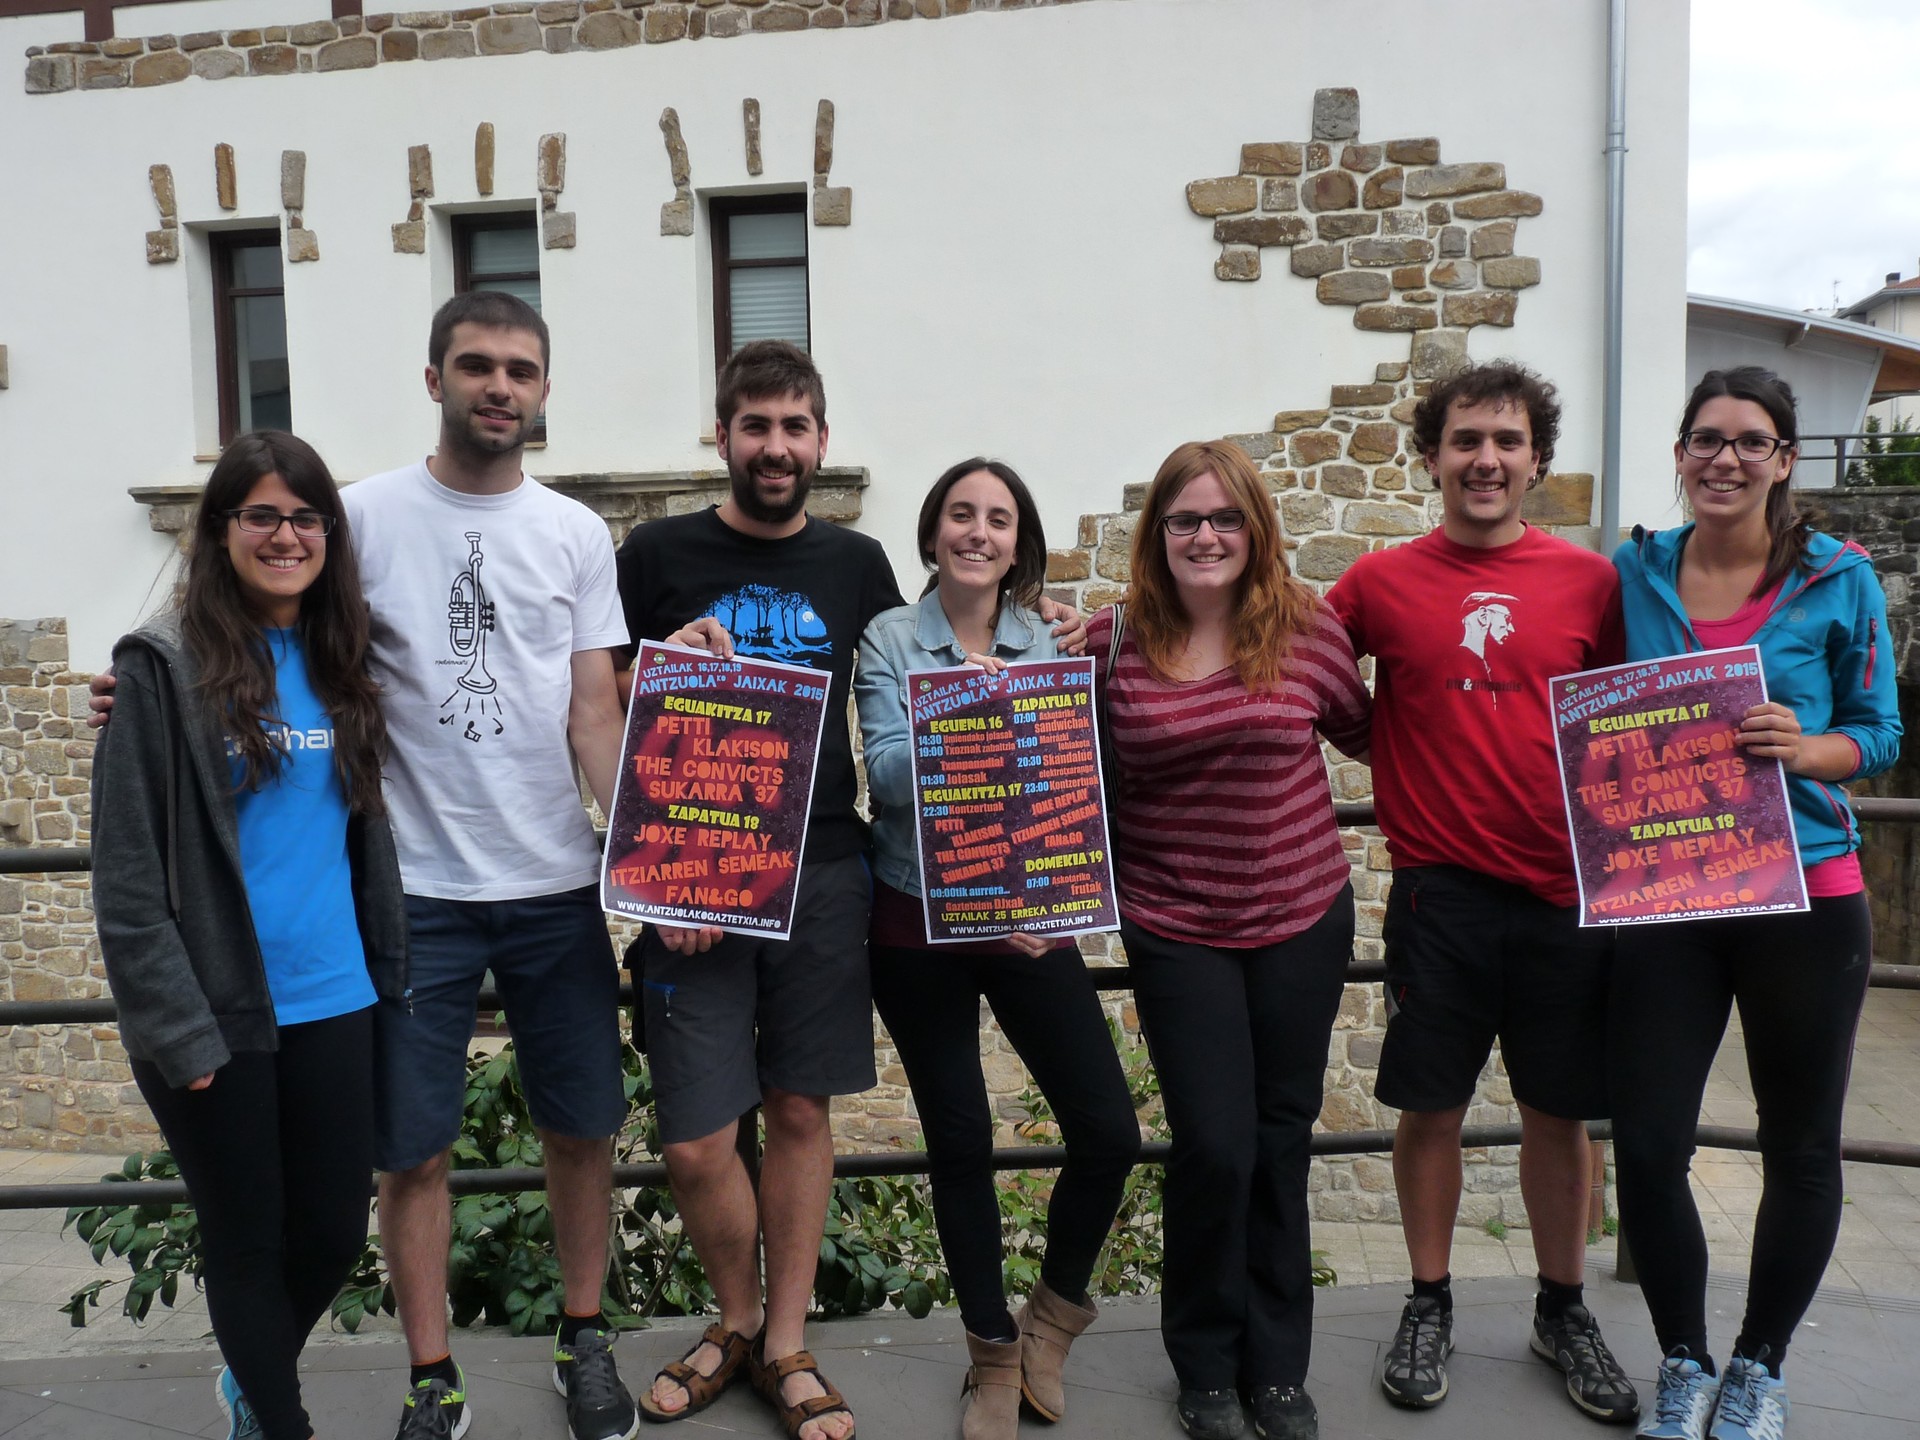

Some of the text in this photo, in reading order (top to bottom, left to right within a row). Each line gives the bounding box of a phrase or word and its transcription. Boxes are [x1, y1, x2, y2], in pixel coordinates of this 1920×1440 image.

[643, 662, 742, 678] UZTAILAK 16,17,18,19
[1656, 666, 1716, 690] JAIXAK
[1724, 662, 1758, 678] 2015
[733, 676, 787, 693] JAIXAK
[793, 683, 824, 700] 2015
[1006, 675, 1055, 694] JAIXAK
[1062, 672, 1091, 685] 2015
[1558, 664, 1661, 711] UZTAILAK 16,17,18,19
[914, 681, 962, 708] UZTAILAK
[1012, 692, 1087, 712] ZAPATUA 18
[664, 695, 772, 724] EGUAKITZA 17
[1014, 712, 1036, 724] 07:00
[1588, 703, 1709, 734] EGUAKITZA 17
[656, 716, 711, 735] PETTI
[930, 716, 1003, 733] EGUENA 16
[1034, 716, 1089, 733] sandwichak
[693, 738, 789, 760] KLAK!SON
[918, 735, 942, 745] 14:30
[918, 746, 943, 757] 19:00
[944, 744, 981, 755] Txoznak
[1016, 737, 1038, 748] 11:00
[1587, 730, 1649, 760] PETTI
[634, 755, 783, 785] THE CONVICTS
[1017, 756, 1042, 767] 20:30
[921, 774, 945, 785] 01:30
[1025, 776, 1099, 794] 23:00 Kontzertuak
[1577, 757, 1746, 805] THE CONVICTS
[649, 781, 778, 803] SUKARRA 37
[923, 783, 1022, 803] EGUAKITZA 17
[1031, 788, 1088, 816] JOXE REPLAY
[1602, 778, 1744, 825] SUKARRA 37
[668, 805, 760, 829] ZAPATUA 18
[923, 802, 1004, 817] 22:30 Kontzertuak
[935, 819, 965, 832] PETTI
[1011, 803, 1099, 844] ITZIARREN SEMEAK
[1630, 814, 1735, 840] ZAPATUA 18
[633, 825, 772, 851] JOXE REPLAY
[1045, 831, 1083, 848] FAN&GO
[935, 842, 1011, 864] THE CONVICTS
[1025, 850, 1103, 872] DOMEKIA 19
[1603, 827, 1755, 874] JOXE REPLAY
[611, 852, 795, 886] ITZIARREN SEMEAK
[941, 857, 1006, 884] SUKARRA 37
[1589, 839, 1792, 914] ITZIARREN SEMEAK
[1026, 873, 1091, 889] 07:00 Askotariko
[1071, 881, 1102, 895] frutak
[665, 885, 753, 907] FAN&GO
[930, 887, 968, 898] 00:00tik
[1654, 889, 1755, 913] FAN&GO
[617, 900, 781, 929] WWW.ANTZUOLAKOGAZTETXIA.INFO
[941, 899, 1102, 921] UZTAILAK 25 ERREKA GARBITZIA
[945, 896, 1024, 912] Gaztetxian DJxak
[1599, 903, 1797, 924] WWW.ANTZUOLAKOGAZTETXIA.INFO
[950, 916, 1093, 934] WWW.ANTZUOLAKOGAZTETXIA.INFO
